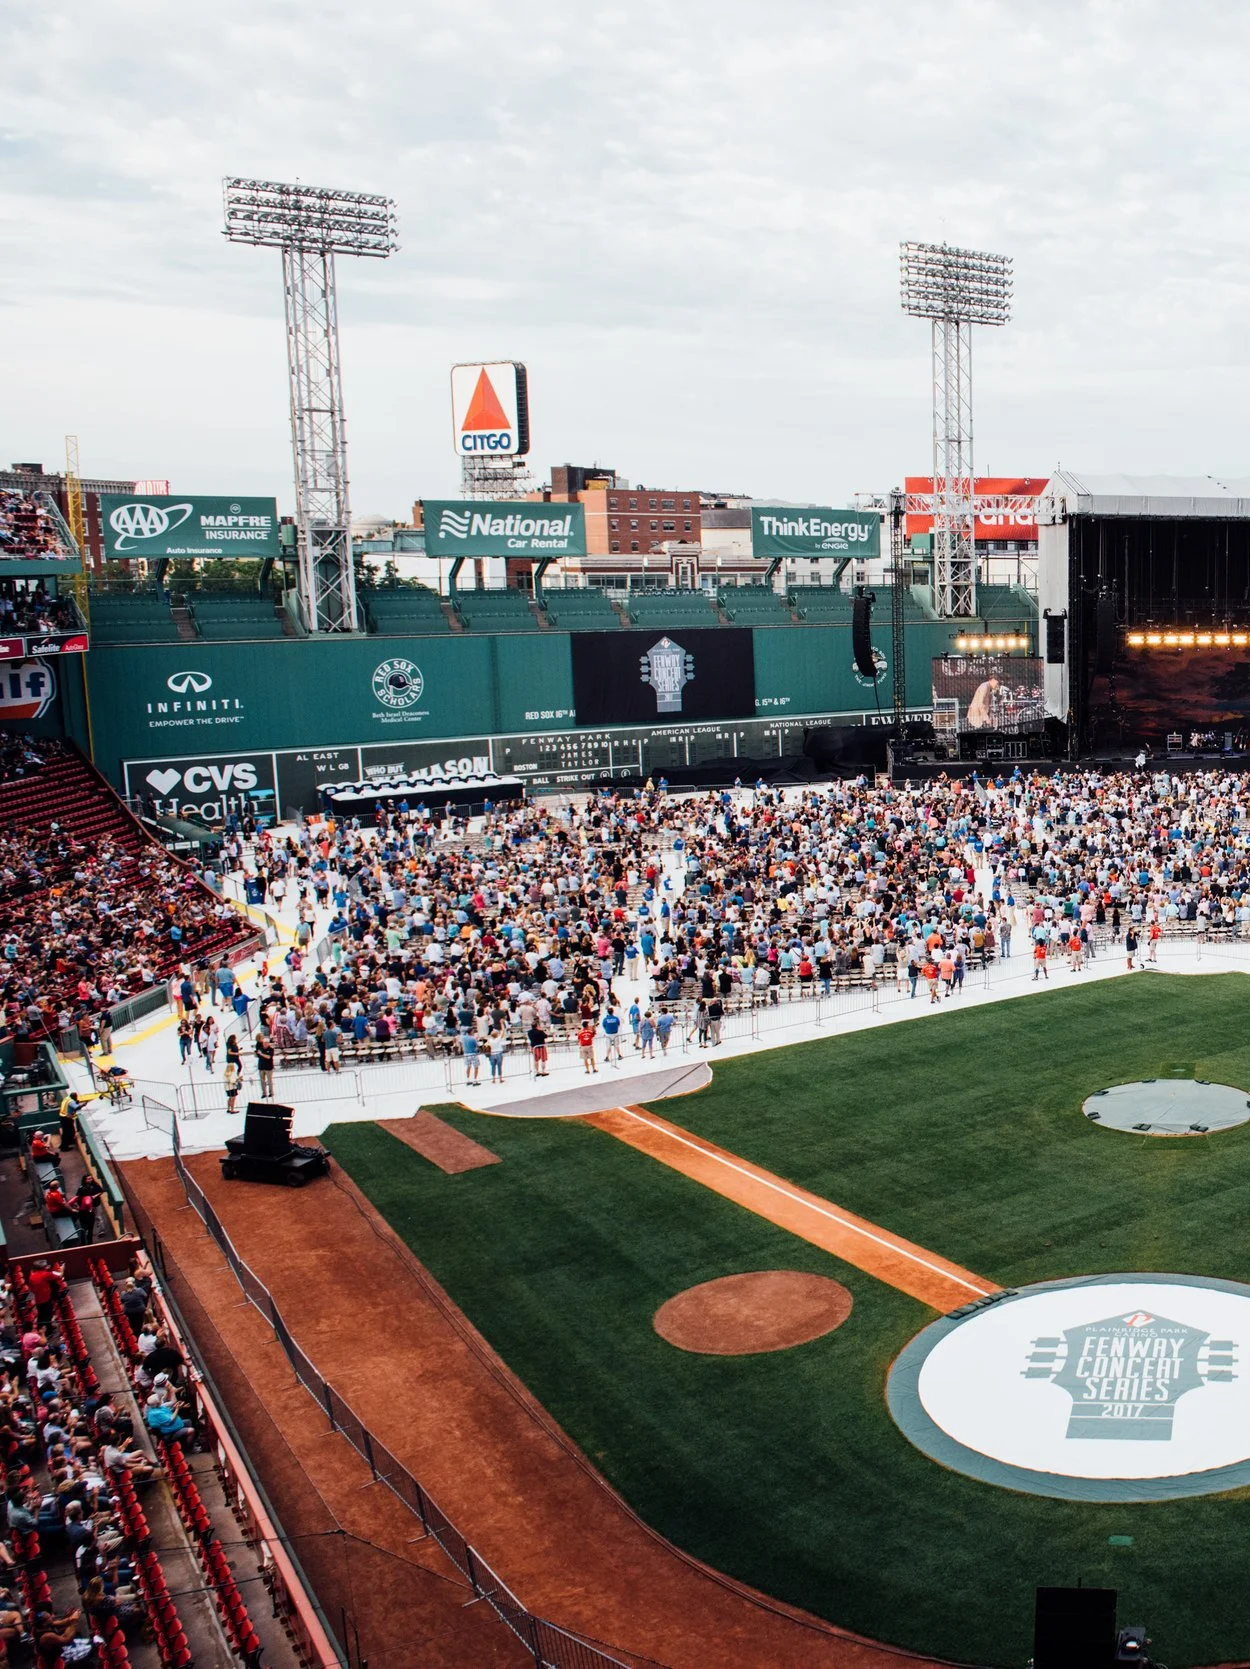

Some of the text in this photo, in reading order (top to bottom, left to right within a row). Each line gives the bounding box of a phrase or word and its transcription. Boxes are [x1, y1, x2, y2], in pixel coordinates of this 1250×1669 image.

[461, 432, 511, 451] CITGO
[117, 505, 163, 537] AAA
[200, 515, 272, 527] MAPFRE
[470, 513, 572, 536] National
[759, 516, 869, 541] ThinkEnergy
[205, 530, 270, 540] INSURANCE
[507, 538, 568, 548] Car Rental
[32, 643, 60, 654] Safelite
[653, 654, 680, 668] FENWAY
[375, 660, 414, 683] RED SOX
[377, 677, 421, 706] SCHOLARS
[657, 680, 680, 692] SERIES
[147, 698, 241, 713] INFINITI
[525, 711, 539, 720] RED
[540, 711, 555, 719] SOX
[149, 716, 241, 728] EMPOWER THE DRIVE
[769, 721, 803, 729] NATIONAL
[651, 726, 721, 736] AMERICAN LEAGUE
[522, 733, 611, 745] FENWAY PARK
[313, 752, 340, 760] EAST
[560, 750, 593, 759] JAMES
[316, 764, 326, 772] W
[513, 763, 538, 772] BOSTON
[561, 759, 599, 768] TAYLOR
[365, 764, 404, 776] WHO BUT
[183, 762, 258, 793] CVS
[532, 777, 550, 785] BALL
[556, 774, 579, 783] STRIKE
[1082, 1336, 1185, 1358] FENWAY
[1075, 1356, 1185, 1379] CONCERT
[1082, 1377, 1170, 1401] SERIES
[1101, 1404, 1145, 1417] 2017
